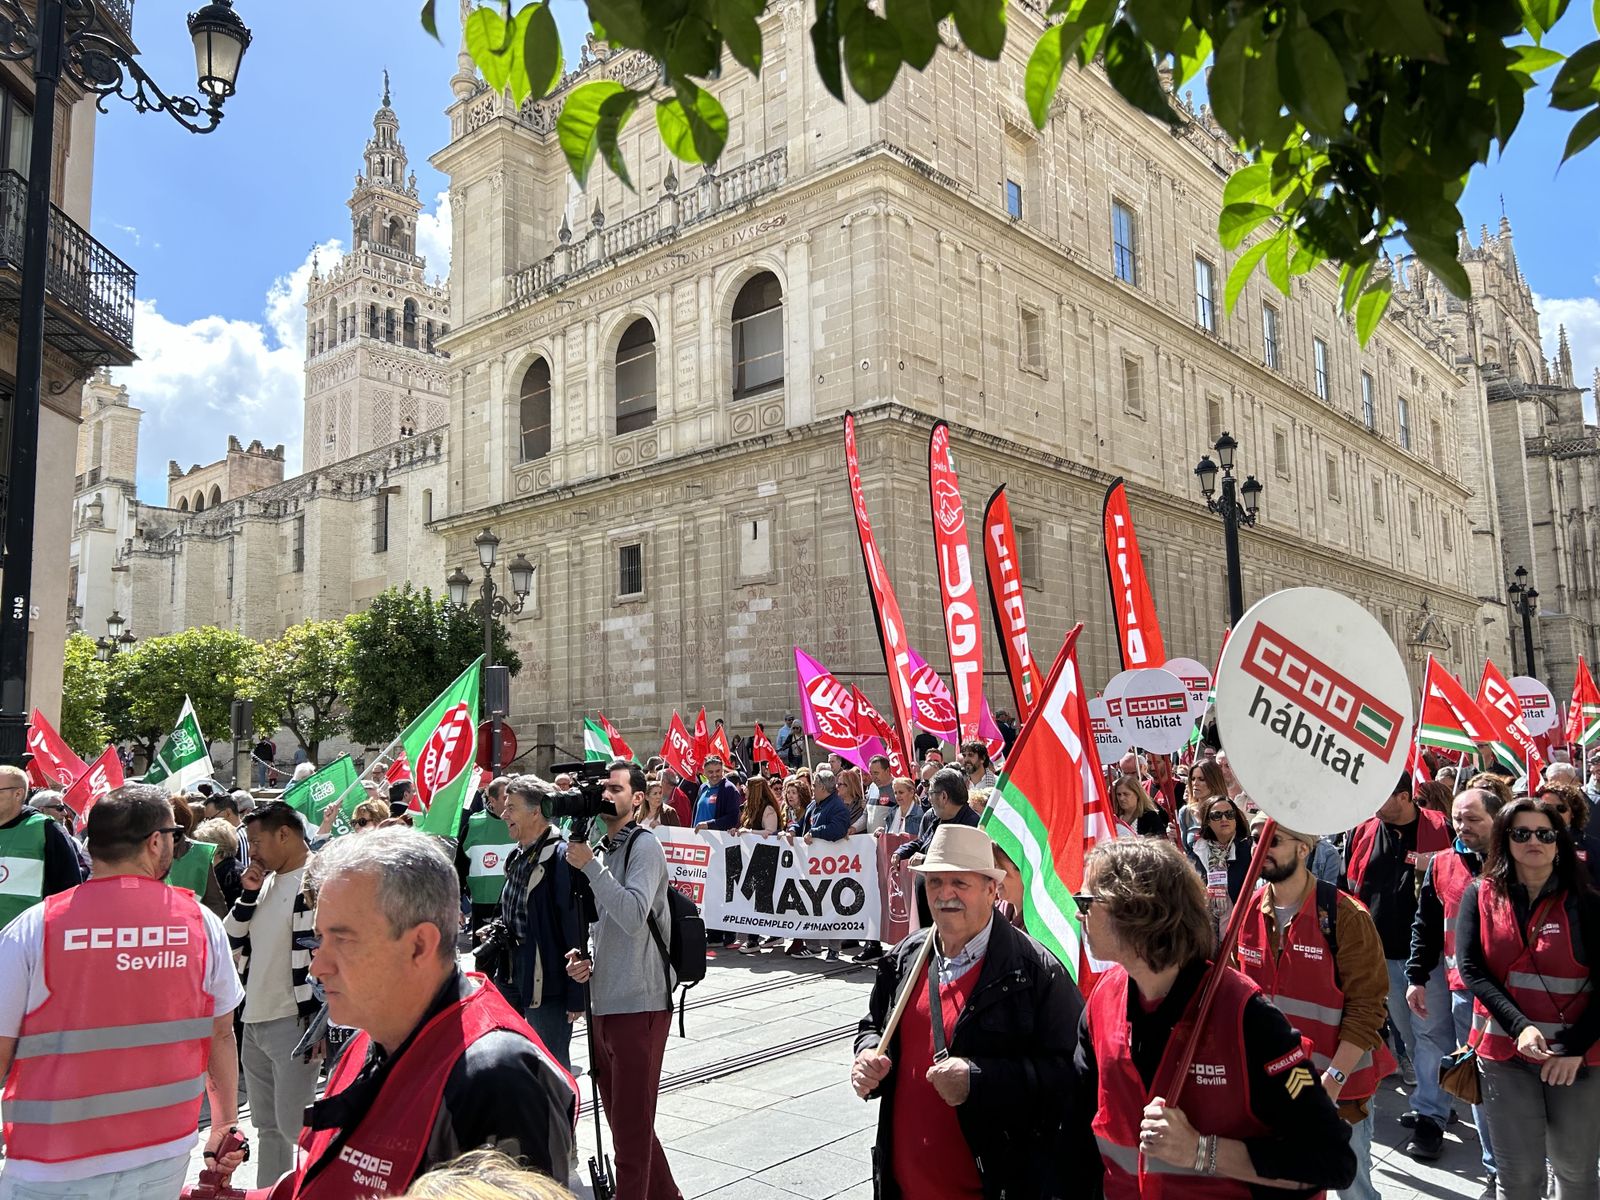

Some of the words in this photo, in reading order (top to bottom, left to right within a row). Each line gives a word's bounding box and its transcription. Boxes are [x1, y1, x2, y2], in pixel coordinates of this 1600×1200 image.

[588, 277, 641, 303] MEMORIA
[645, 244, 714, 280] PASSIONIS
[722, 226, 757, 249] EIVS
[941, 543, 978, 714] UGT
[1252, 636, 1356, 723] CCOO
[810, 677, 855, 718] UG
[1128, 698, 1168, 713] CCOO
[1136, 714, 1182, 729] hábitat
[1248, 685, 1366, 786] hábitat
[1505, 722, 1541, 761] Sevilla
[664, 846, 695, 861] COO
[675, 866, 707, 878] Sevilla
[808, 854, 862, 875] 2024
[722, 914, 794, 930] #PLENOEMPLEO
[802, 921, 865, 932] #1MAYO2024
[64, 926, 164, 951] CCOO
[1293, 944, 1316, 954] CCOO
[116, 951, 188, 971] Sevilla
[1304, 953, 1323, 961] Sevilla
[1196, 1075, 1227, 1085] Sevilla
[339, 1145, 381, 1173] CCOO
[353, 1170, 388, 1191] Sevilla
